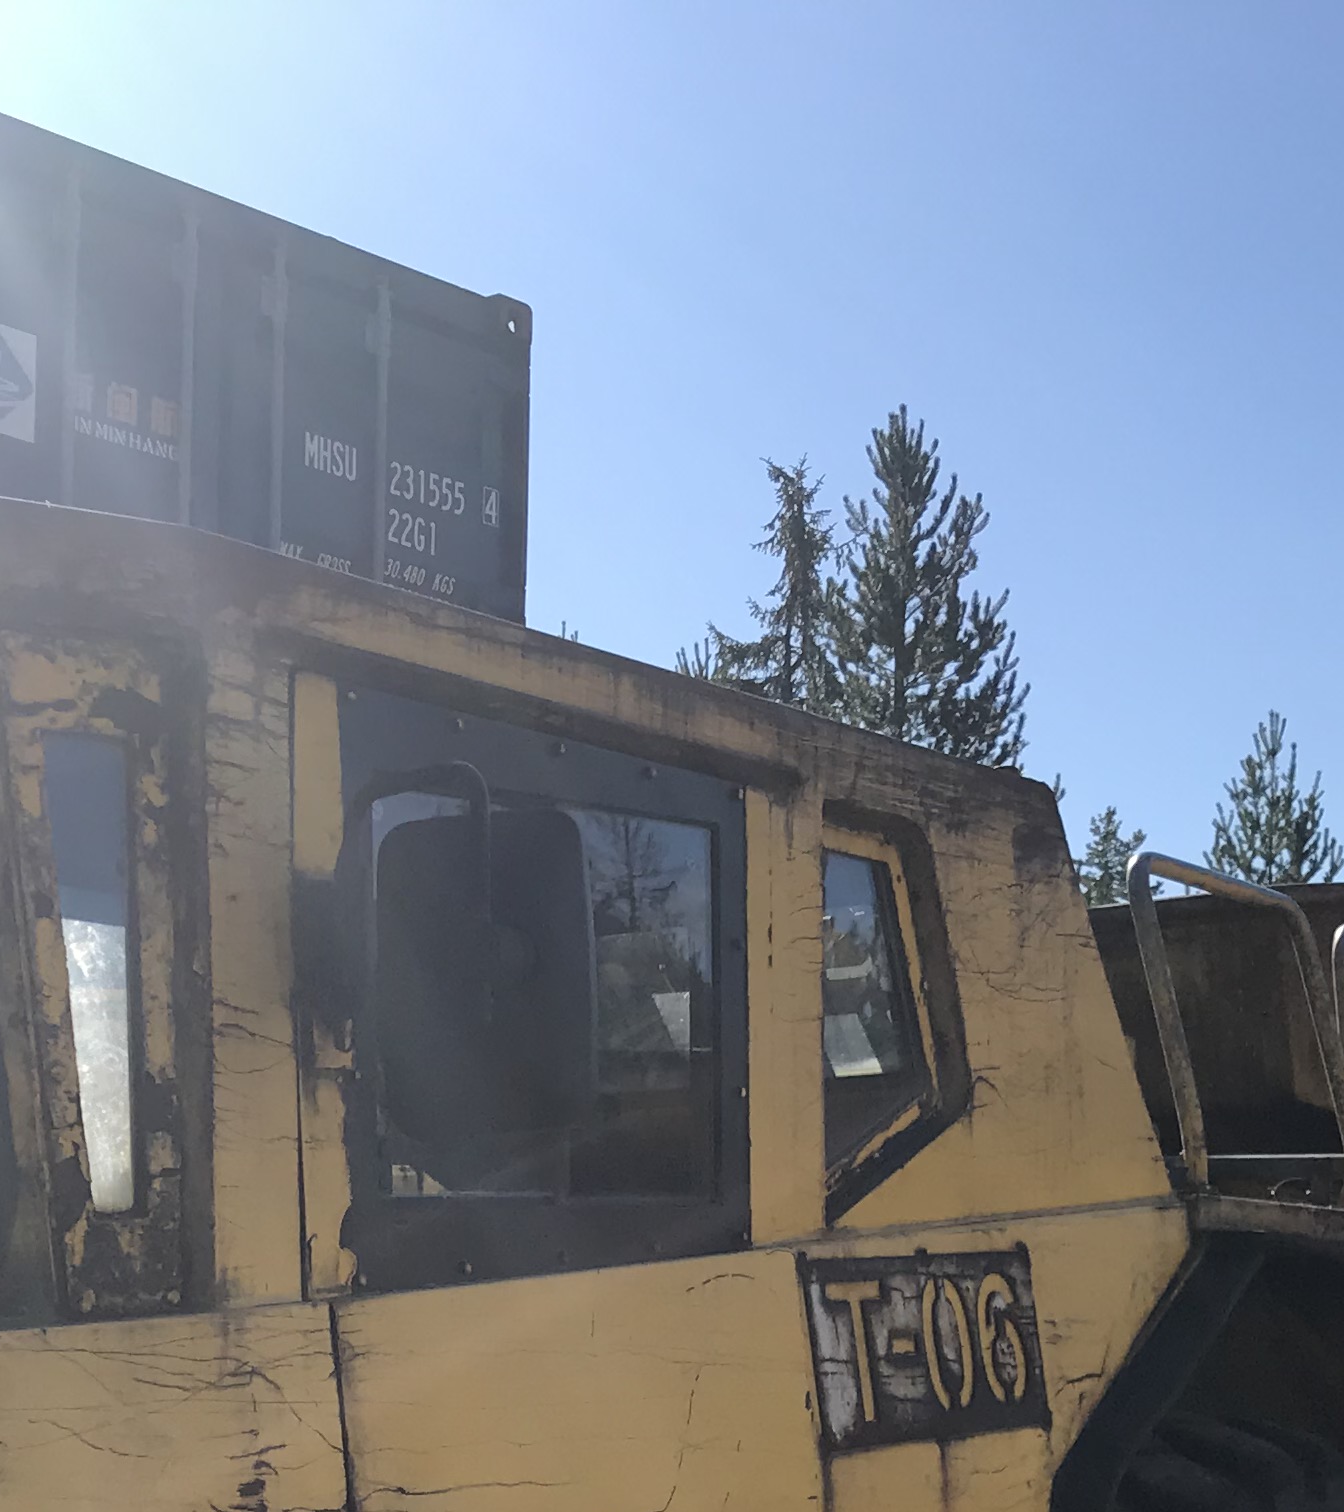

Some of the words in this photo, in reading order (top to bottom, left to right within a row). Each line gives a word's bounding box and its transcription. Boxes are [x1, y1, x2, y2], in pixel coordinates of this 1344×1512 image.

[303, 431, 357, 482] MHSU
[388, 460, 466, 516] 231555
[484, 489, 498, 524] 4
[387, 507, 436, 557] 22G1
[279, 541, 304, 560] MAX
[383, 558, 427, 586] 30.480
[431, 573, 456, 595] KGS
[824, 1272, 1027, 1423] T-06
